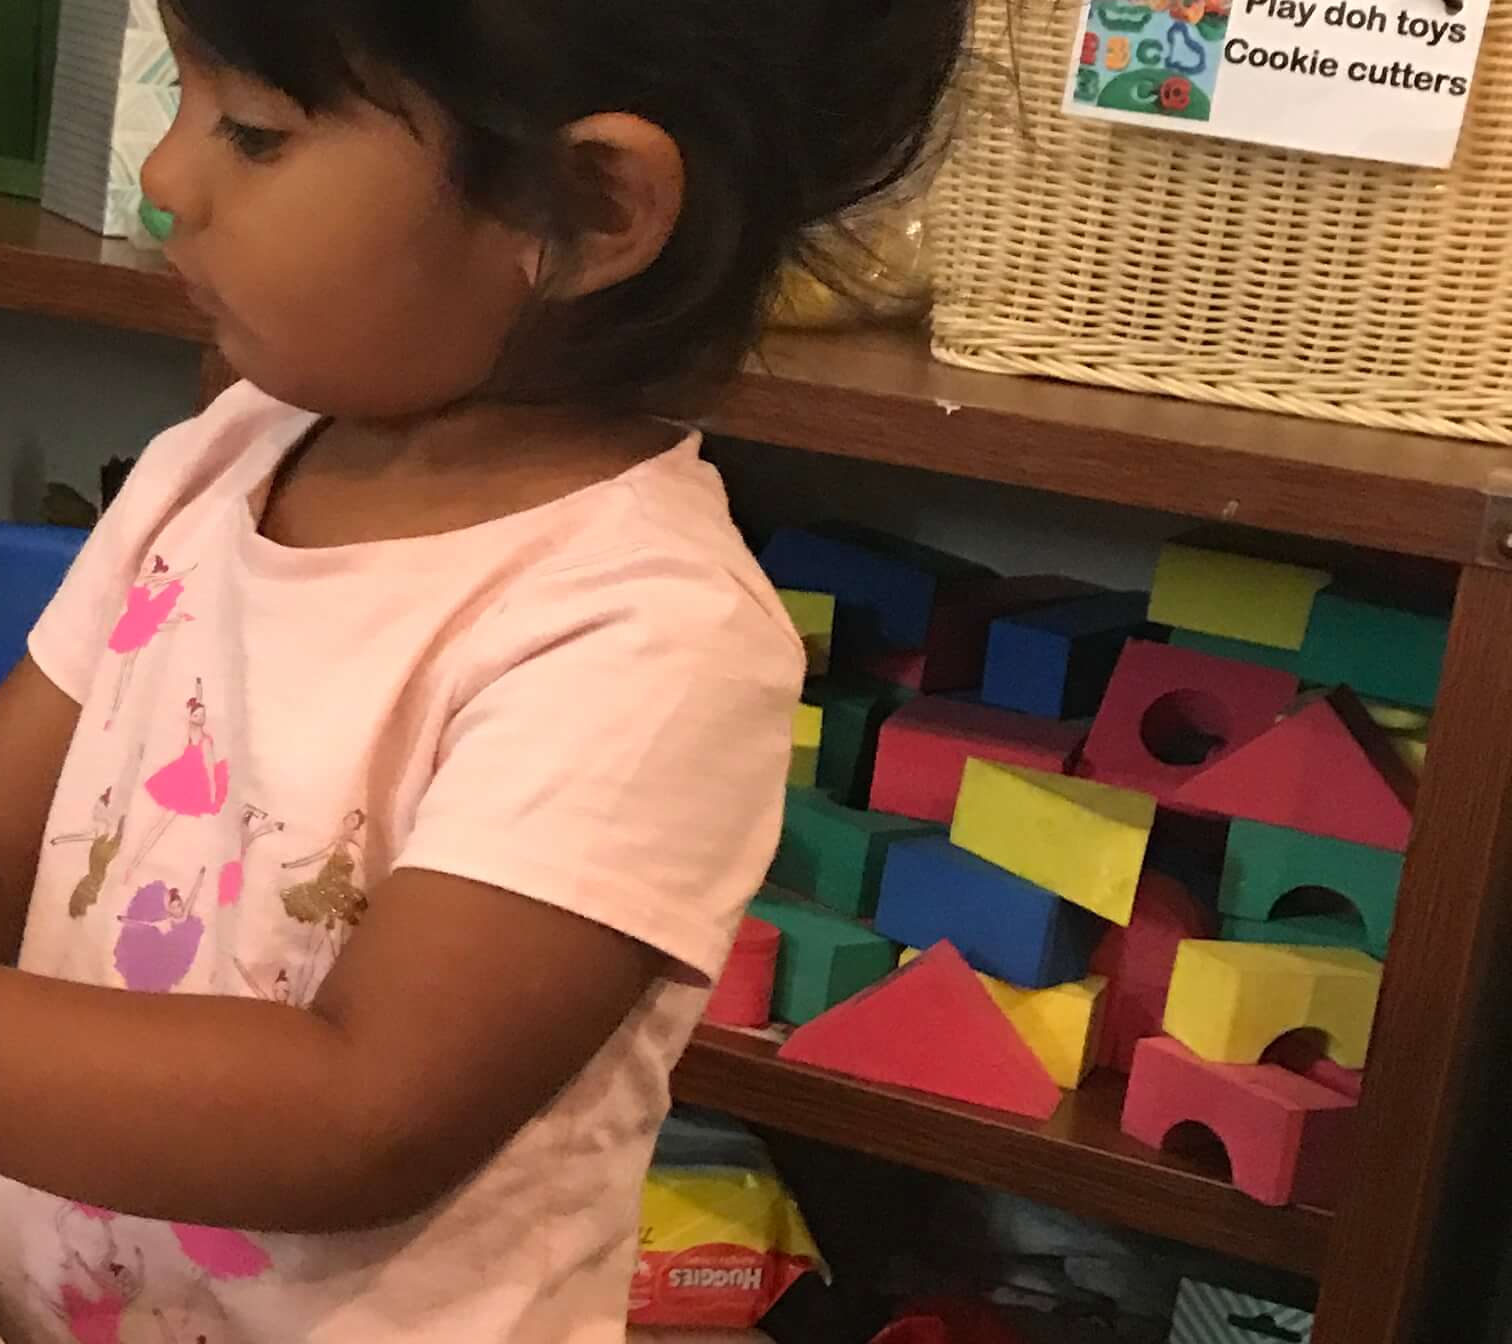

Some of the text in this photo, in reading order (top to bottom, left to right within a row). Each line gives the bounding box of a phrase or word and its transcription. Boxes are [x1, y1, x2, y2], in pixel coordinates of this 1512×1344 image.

[1325, 0, 1387, 34] doh
[1398, 8, 1467, 48] toys
[1223, 38, 1468, 97] Cookie cutters
